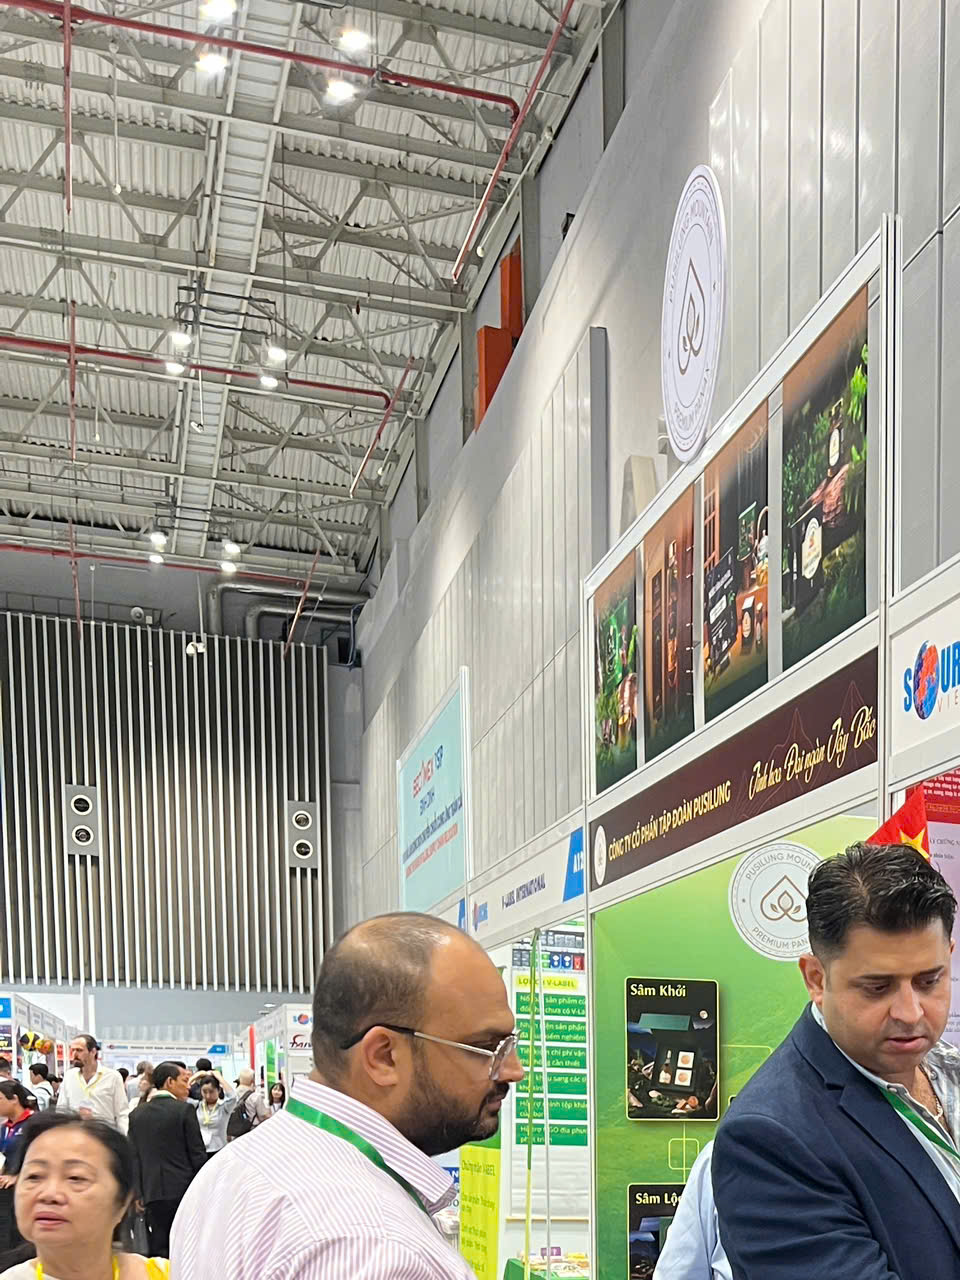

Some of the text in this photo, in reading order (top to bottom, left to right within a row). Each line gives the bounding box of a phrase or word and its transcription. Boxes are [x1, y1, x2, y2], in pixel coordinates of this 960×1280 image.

[693, 780, 731, 818] PUSILUNG
[745, 853, 814, 880] PUSILUNG MOUN
[752, 926, 808, 950] PREMIUM PAN
[630, 984, 686, 997] Sâm Khởi
[635, 1192, 660, 1204] Sâm
